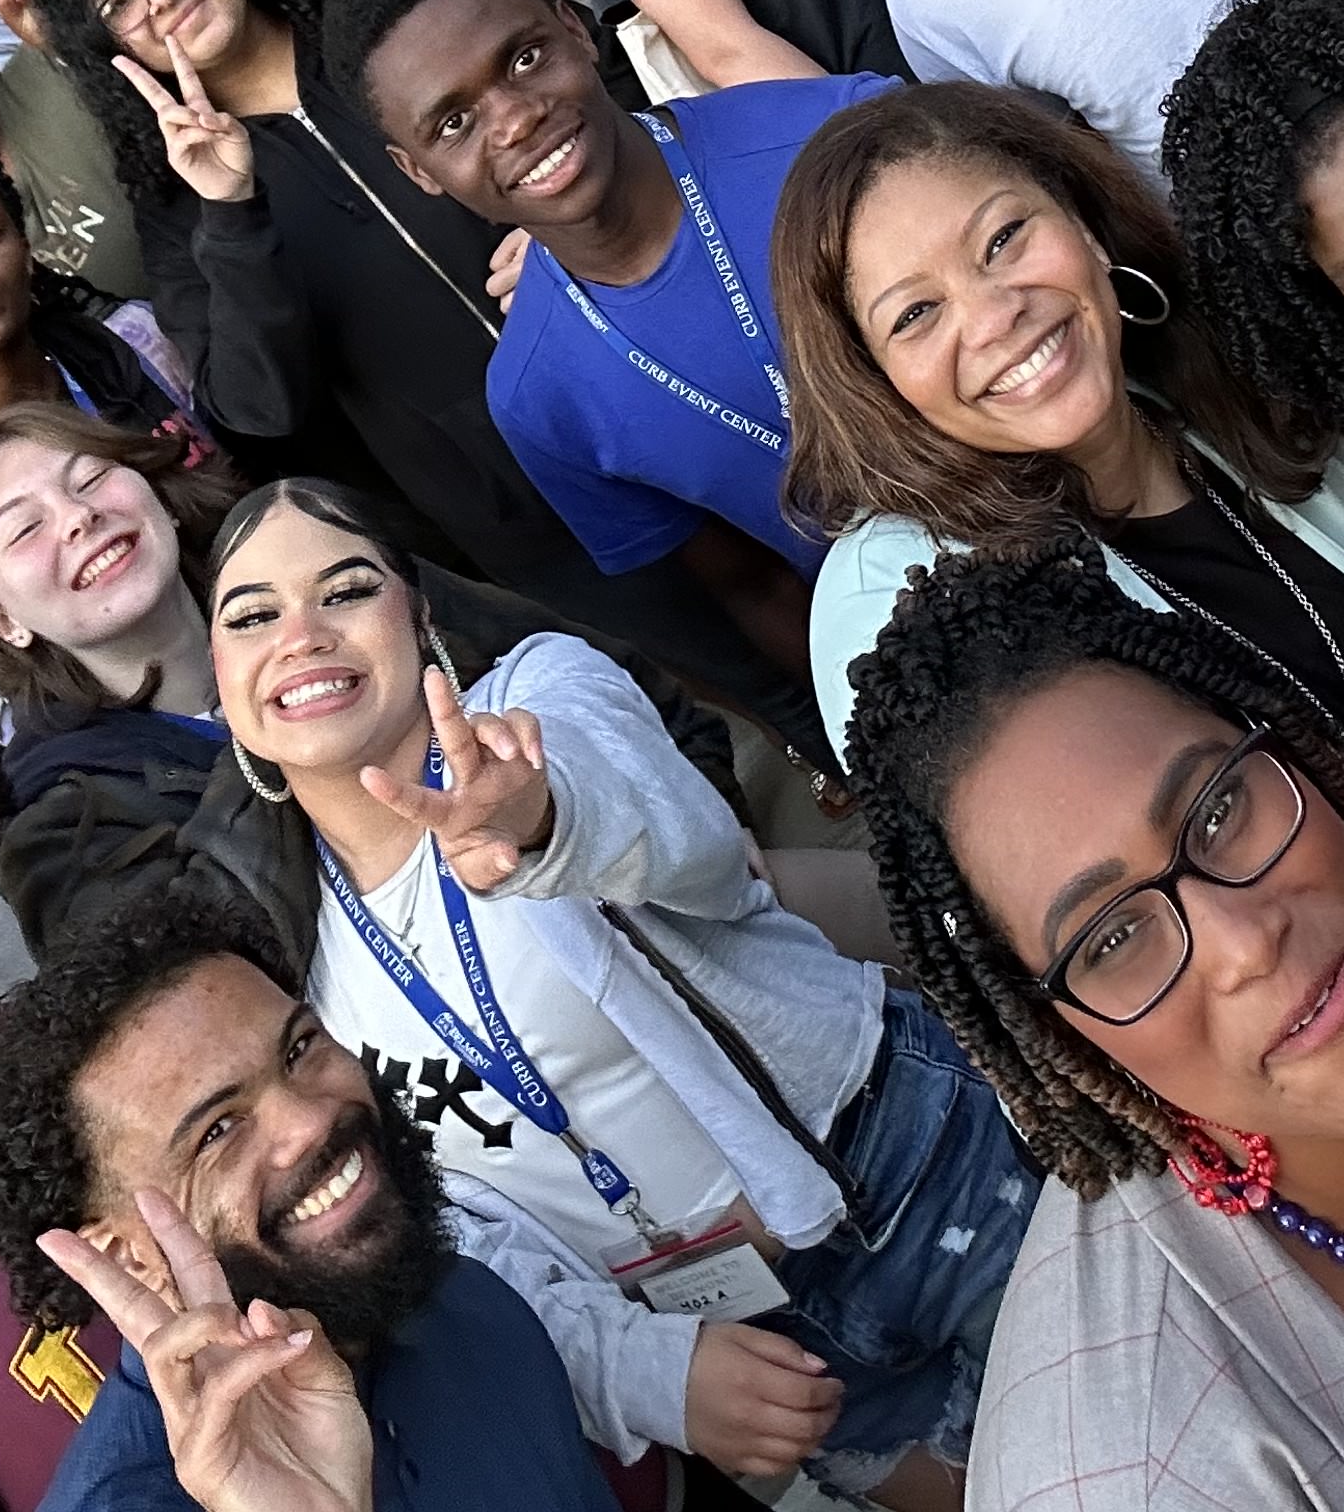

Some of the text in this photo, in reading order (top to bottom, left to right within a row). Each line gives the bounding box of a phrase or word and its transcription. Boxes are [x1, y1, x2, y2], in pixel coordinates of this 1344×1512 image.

[679, 173, 758, 338] CURB EVENT CENTER
[628, 350, 783, 450] CURB EVENT CENTER
[315, 838, 414, 986] CURB EVENT CENTER
[451, 1028, 492, 1069] BELMONT
[455, 920, 547, 1107] CURB EVENT CENTER
[680, 1290, 728, 1310] 402 A
